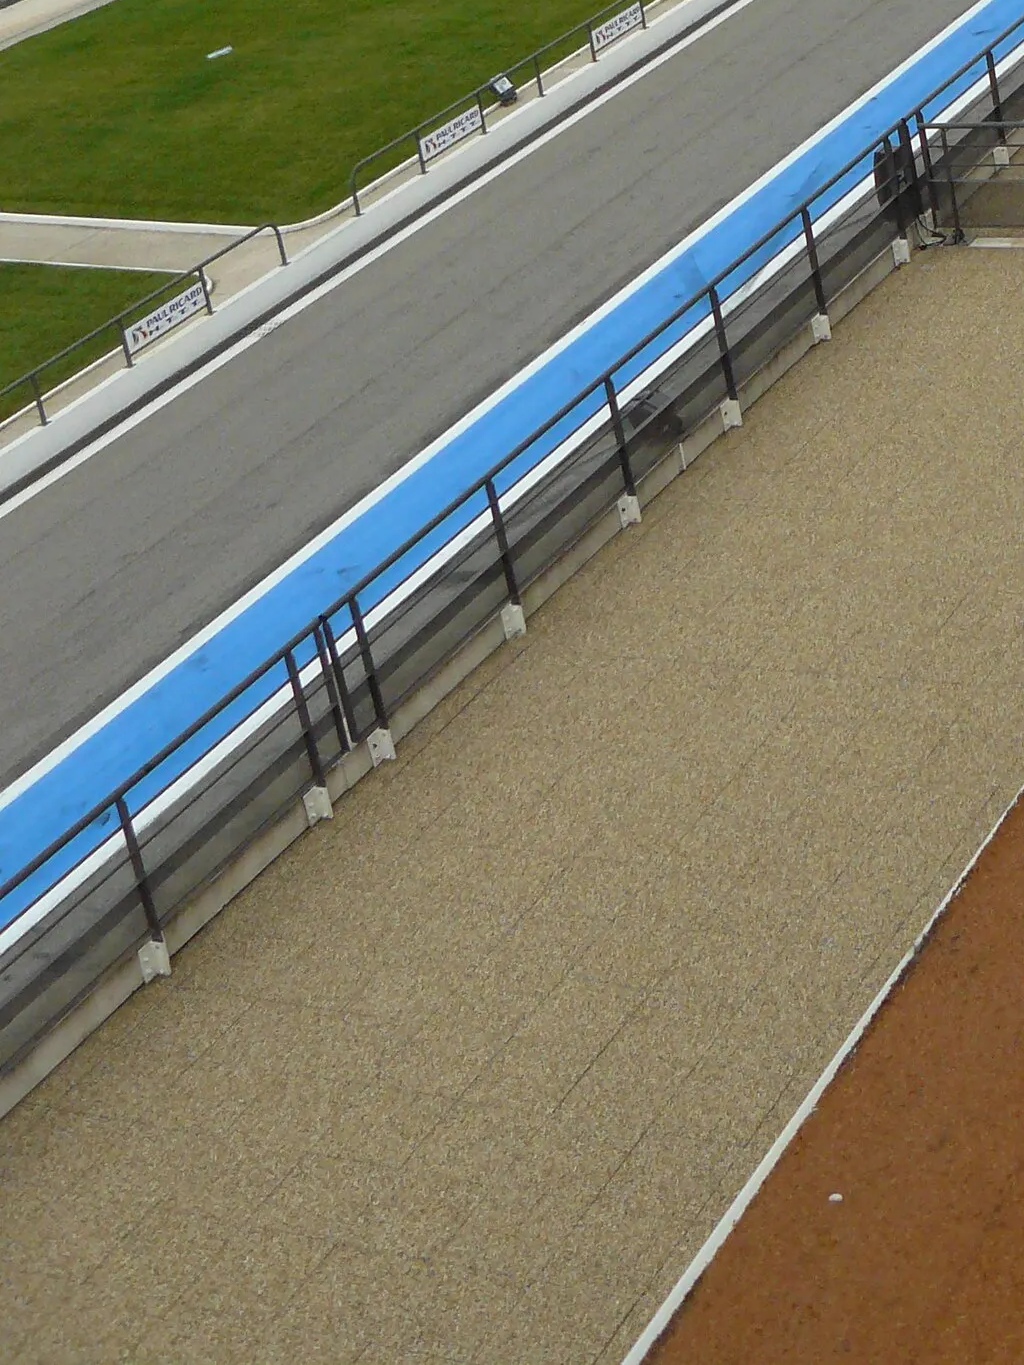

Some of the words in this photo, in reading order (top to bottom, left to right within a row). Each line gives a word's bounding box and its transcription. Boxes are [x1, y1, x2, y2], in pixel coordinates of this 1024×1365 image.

[436, 125, 452, 141] PAUL
[452, 109, 479, 130] RICARD
[146, 309, 168, 327] PAUL
[168, 286, 202, 314] RICARD
